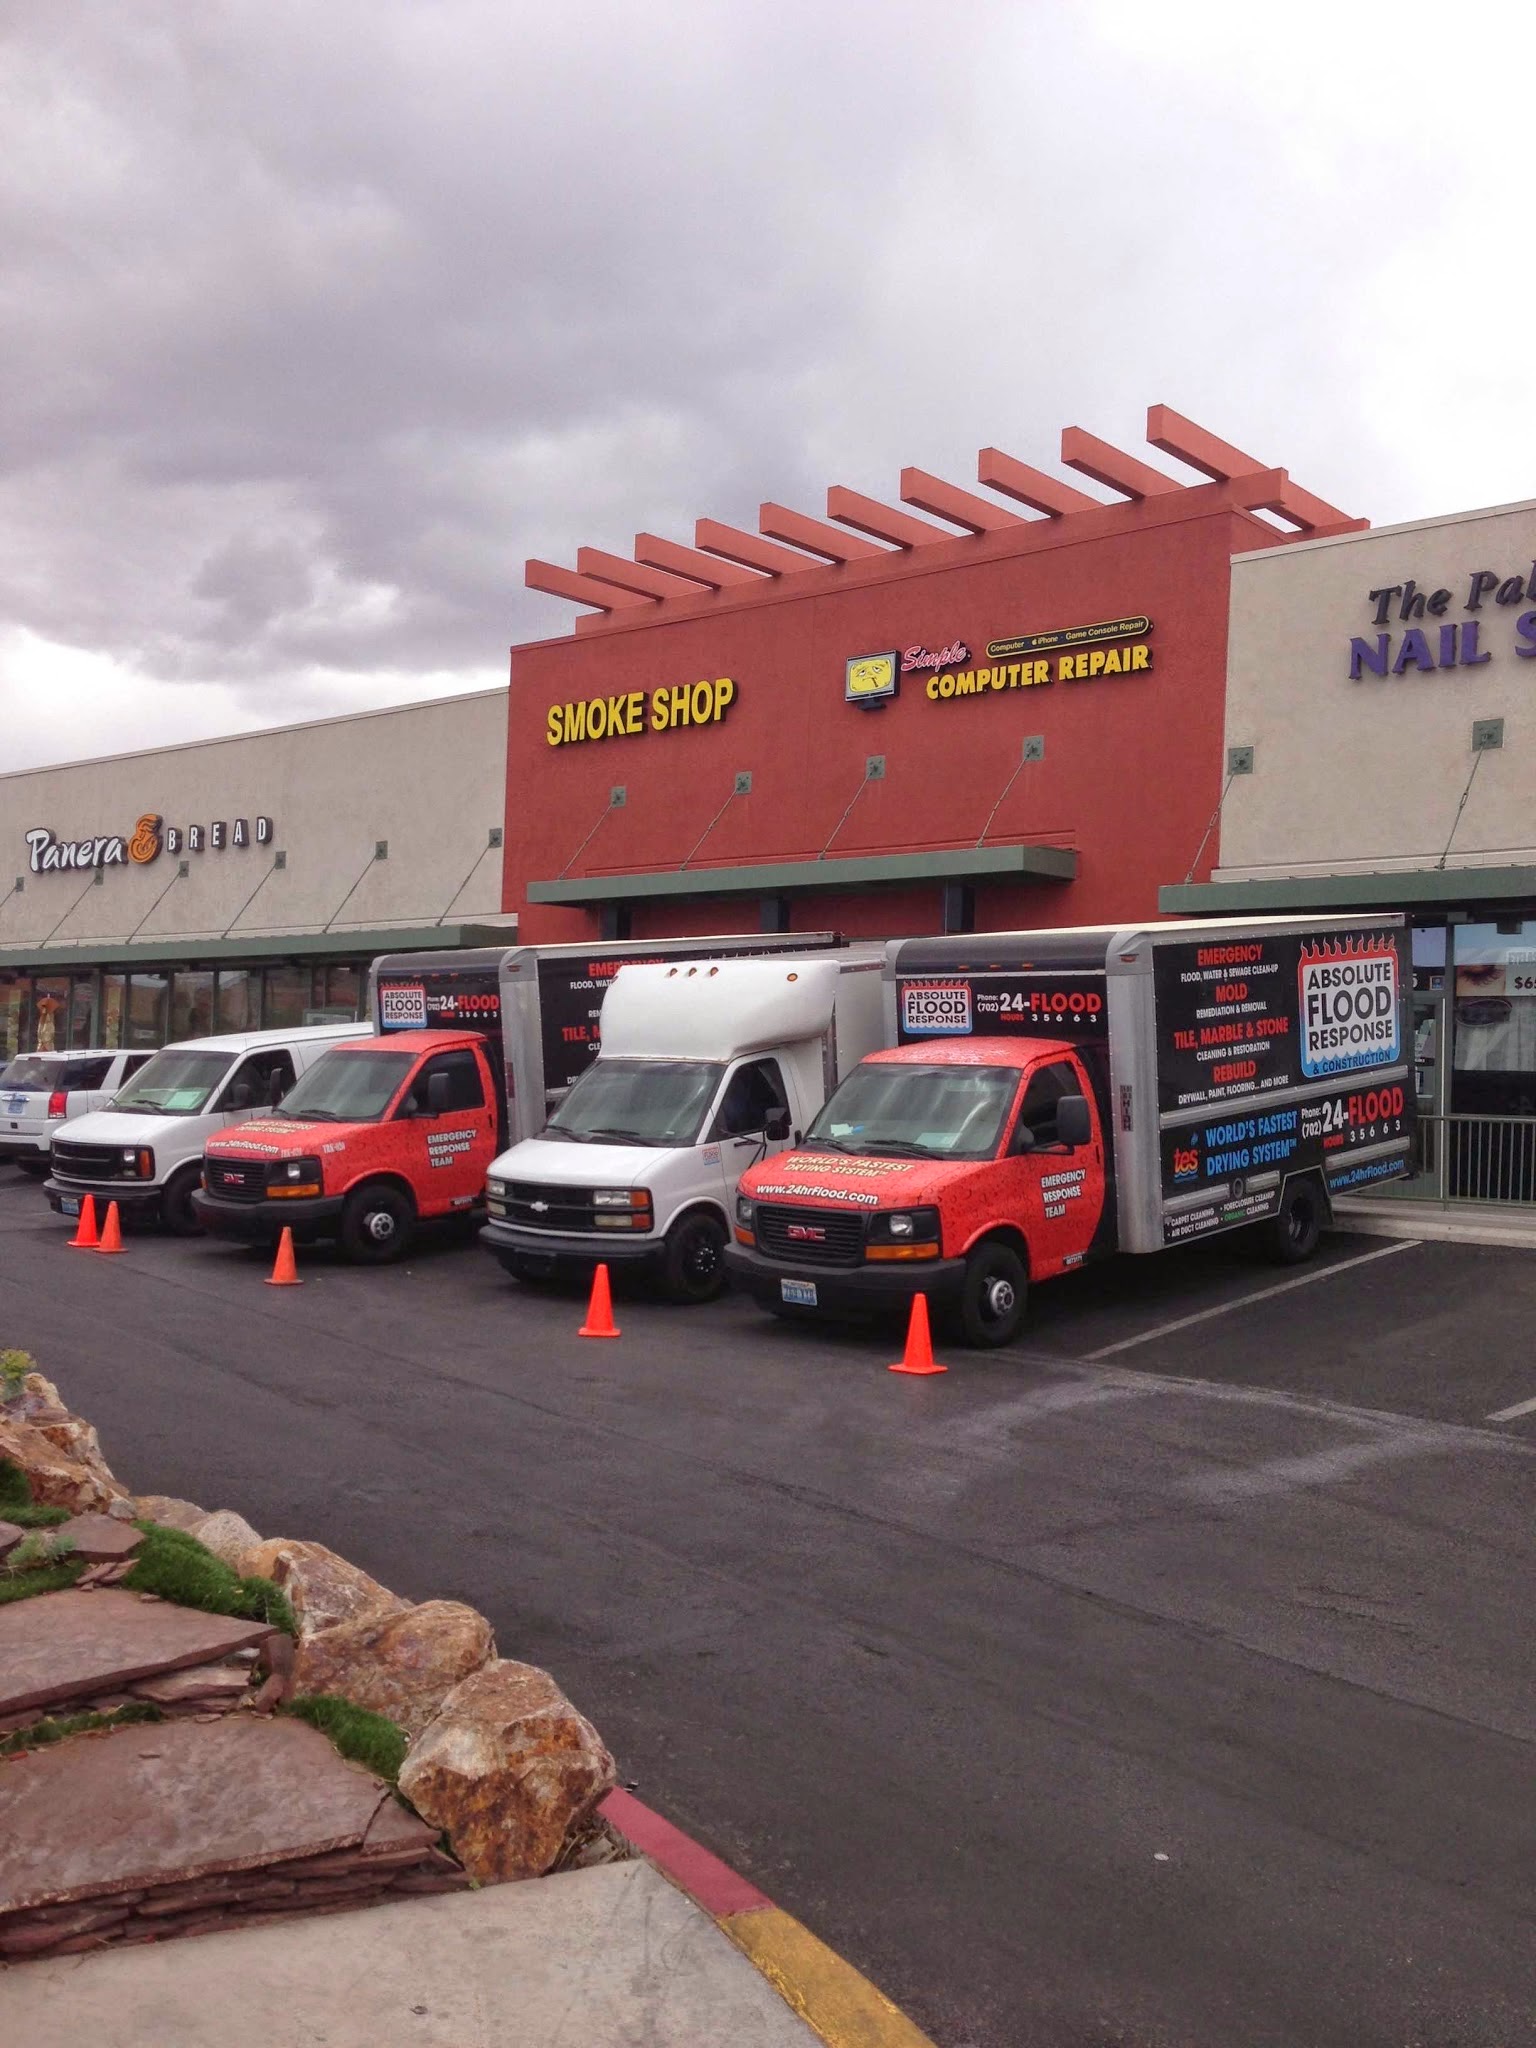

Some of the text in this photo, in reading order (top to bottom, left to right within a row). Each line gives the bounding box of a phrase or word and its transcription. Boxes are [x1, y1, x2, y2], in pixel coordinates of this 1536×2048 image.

[1369, 580, 1453, 625] The
[990, 620, 1145, 653] Computer iPhone Game Console Repair
[901, 641, 967, 673] Simple
[1349, 621, 1492, 680] NAIL
[926, 645, 1149, 699] COMPUTER REPAIR
[547, 677, 735, 746] SMOKE SHOP
[25, 816, 272, 873] Panera BREAD
[1197, 944, 1263, 966] EMERGENCY
[1181, 971, 1202, 982] FLOOD,
[1203, 969, 1222, 980] WATER
[1229, 966, 1251, 977] SEWAGE
[1252, 963, 1278, 975] CLEAN-UP
[1308, 962, 1391, 990] ABSOLUTE
[385, 991, 422, 999] ABSOLUTE
[570, 981, 595, 990] FLOOD,
[1216, 983, 1248, 1002] MOLD
[908, 991, 966, 1000] ABSOLUTE
[385, 1000, 423, 1011] FLOOD
[908, 1001, 966, 1014] FLOOD
[977, 1002, 999, 1012] (702)
[1196, 1005, 1235, 1019] REMEDIATION
[1241, 1001, 1267, 1013] REMOVAL
[1307, 985, 1392, 1027] FLOOD
[908, 1015, 967, 1024] RESPONSE
[562, 1026, 591, 1041] TILE,
[1174, 1017, 1289, 1049] TILE, MARBLE & STONE
[1309, 1019, 1392, 1051] RESPONSE
[1196, 1048, 1226, 1061] CLEANING
[1233, 1041, 1270, 1056] RESTORATION
[1213, 1060, 1256, 1083] REBUILD
[1313, 1050, 1391, 1075] & CONSTRUCTION
[1178, 1092, 1207, 1104] DRYWALL,
[1208, 1087, 1226, 1099] PAINT,
[1261, 1078, 1272, 1088] AND
[1273, 1075, 1289, 1085] MORE
[1301, 1107, 1321, 1119] Phone:
[427, 1129, 477, 1144] EMERGENCY
[1206, 1111, 1297, 1147] WORLD'S FASTEST
[1302, 1120, 1322, 1139] (702)
[429, 1142, 470, 1155] RESPONSE
[430, 1156, 453, 1167] TEAM
[784, 1164, 831, 1173] DRYING
[786, 1156, 915, 1172] WORLD'S FASTEST
[1206, 1149, 1250, 1176] DRYING
[1041, 1169, 1086, 1188] EMERGENCY
[1329, 1159, 1404, 1188] www.24hrFlood.com
[756, 1184, 879, 1205] www.24hrFlood.com
[1043, 1185, 1082, 1203] RESPONSE
[1045, 1204, 1066, 1218] TEAM
[1171, 1208, 1215, 1227] CARPET CLEANING
[1246, 1202, 1269, 1215] CLEANING
[787, 1225, 826, 1241] GMC
[1171, 1217, 1219, 1238] AIR DUCT CLEANING
